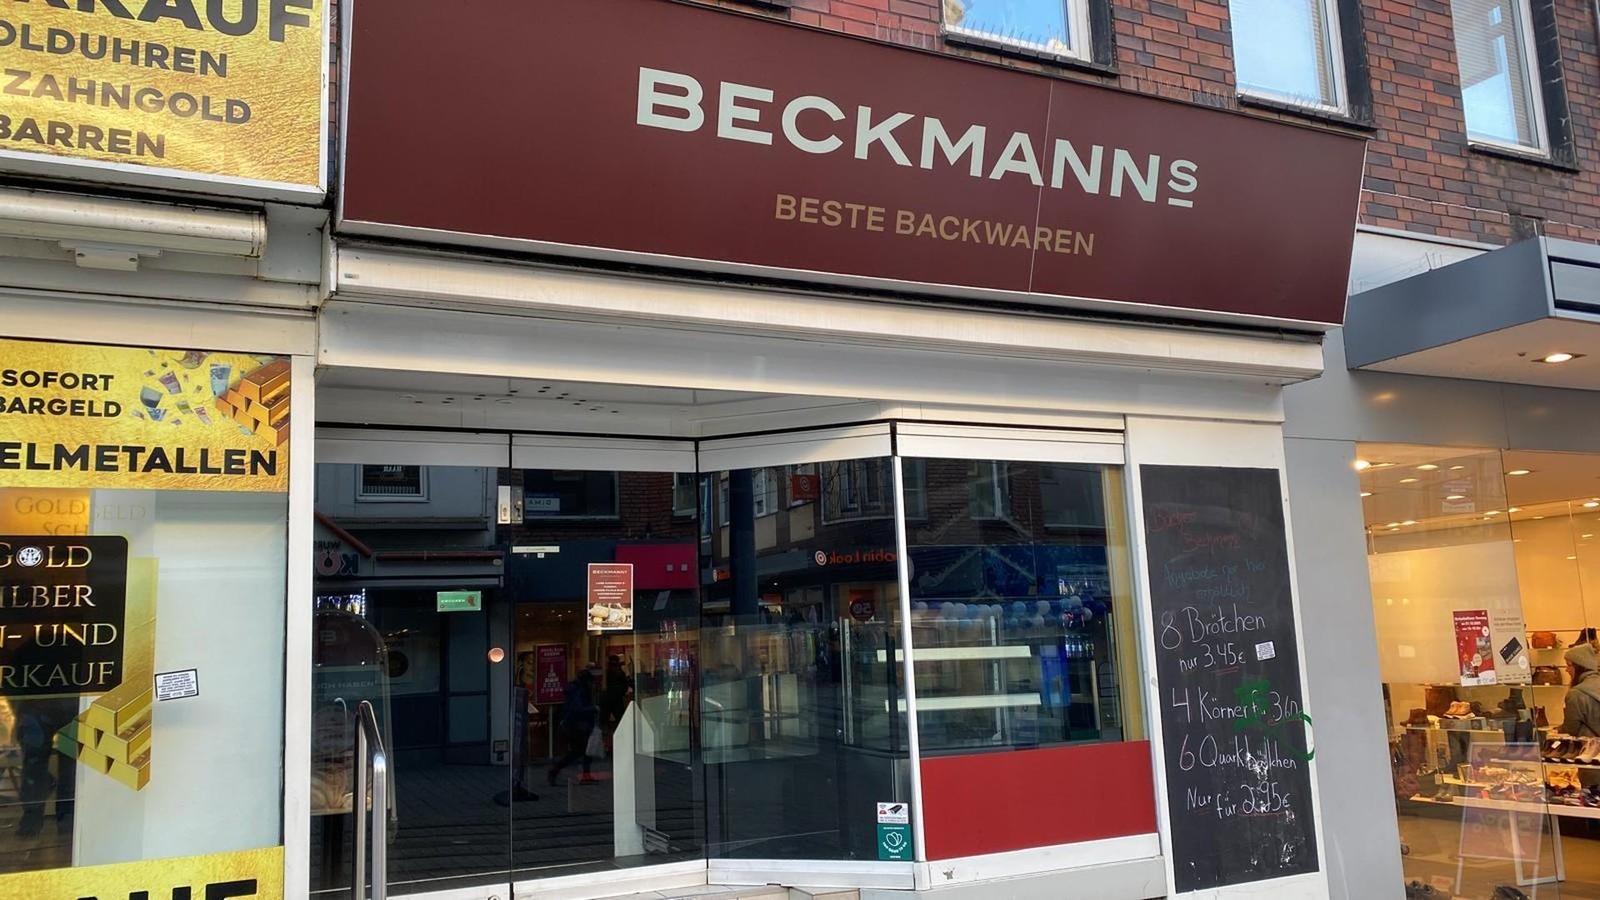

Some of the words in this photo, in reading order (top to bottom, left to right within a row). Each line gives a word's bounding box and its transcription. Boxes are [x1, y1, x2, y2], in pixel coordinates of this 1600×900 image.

[14, 0, 312, 42] AUF
[3, 68, 251, 124] ZAHNGOLD
[775, 194, 886, 232] BESTE
[896, 209, 1095, 256] BACKWAREN
[2, 369, 114, 391] SOFORT
[0, 442, 277, 476] ELMETALLEN
[15, 496, 87, 516] GOLD
[0, 585, 96, 608] ILBER
[34, 623, 118, 648] UND
[1161, 609, 1182, 650] 8
[1181, 603, 1266, 643] Brötchen
[0, 661, 115, 689] RKAUF
[1179, 657, 1198, 672] nur
[1172, 687, 1192, 723] 4
[1179, 733, 1195, 771] 6
[1187, 787, 1212, 811] Nur
